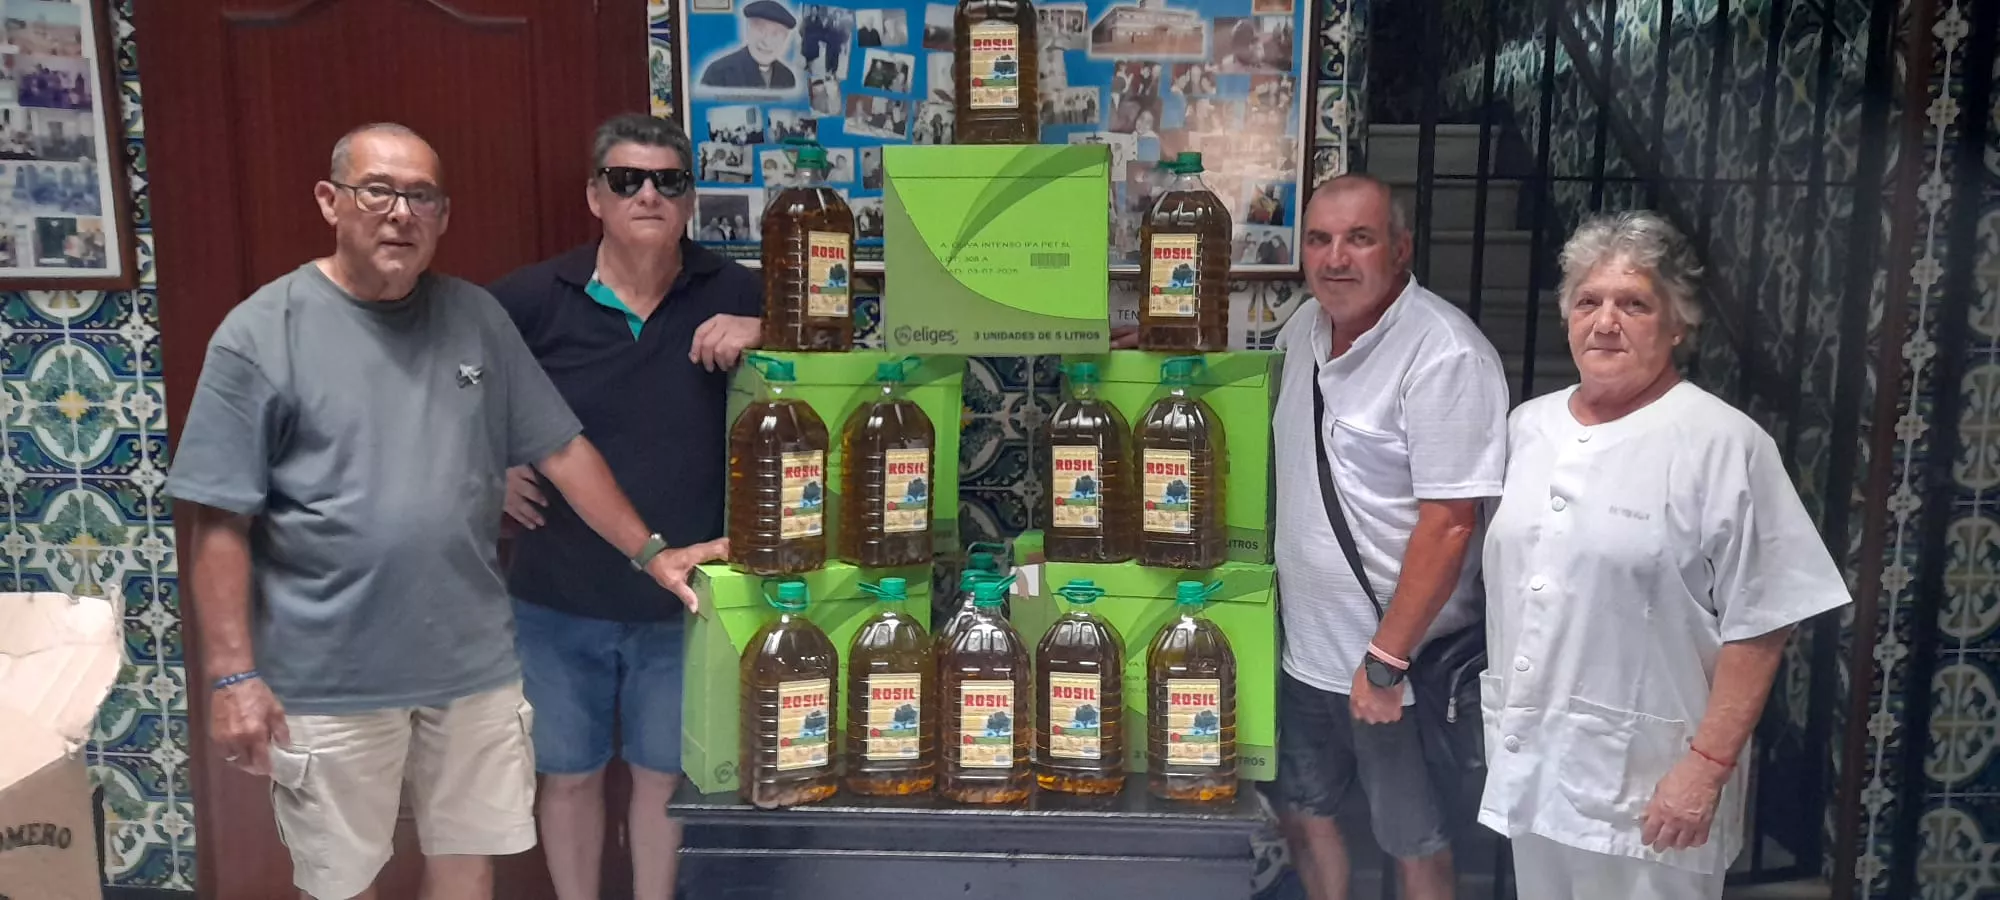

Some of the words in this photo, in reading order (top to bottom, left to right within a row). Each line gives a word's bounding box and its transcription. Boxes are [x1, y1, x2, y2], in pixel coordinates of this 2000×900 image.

[811, 245, 846, 260] ROSIL
[1153, 247, 1193, 259] ROSIL
[913, 326, 954, 346] eliges
[974, 331, 980, 340] 3
[984, 331, 1035, 341] UNIDADES
[1039, 331, 1052, 340] DE
[1056, 331, 1062, 340] 5
[1065, 331, 1100, 341] LITROS
[784, 464, 820, 479] ROSIL
[889, 462, 926, 475] ROSIL
[1056, 459, 1095, 472] ROSIL
[1146, 462, 1187, 476] ROSIL
[872, 687, 915, 700] ROSIL
[1053, 686, 1097, 700] ROSIL
[1171, 693, 1217, 706] ROSIL
[782, 694, 825, 709] ROSIL
[964, 694, 1009, 707] ROSIL
